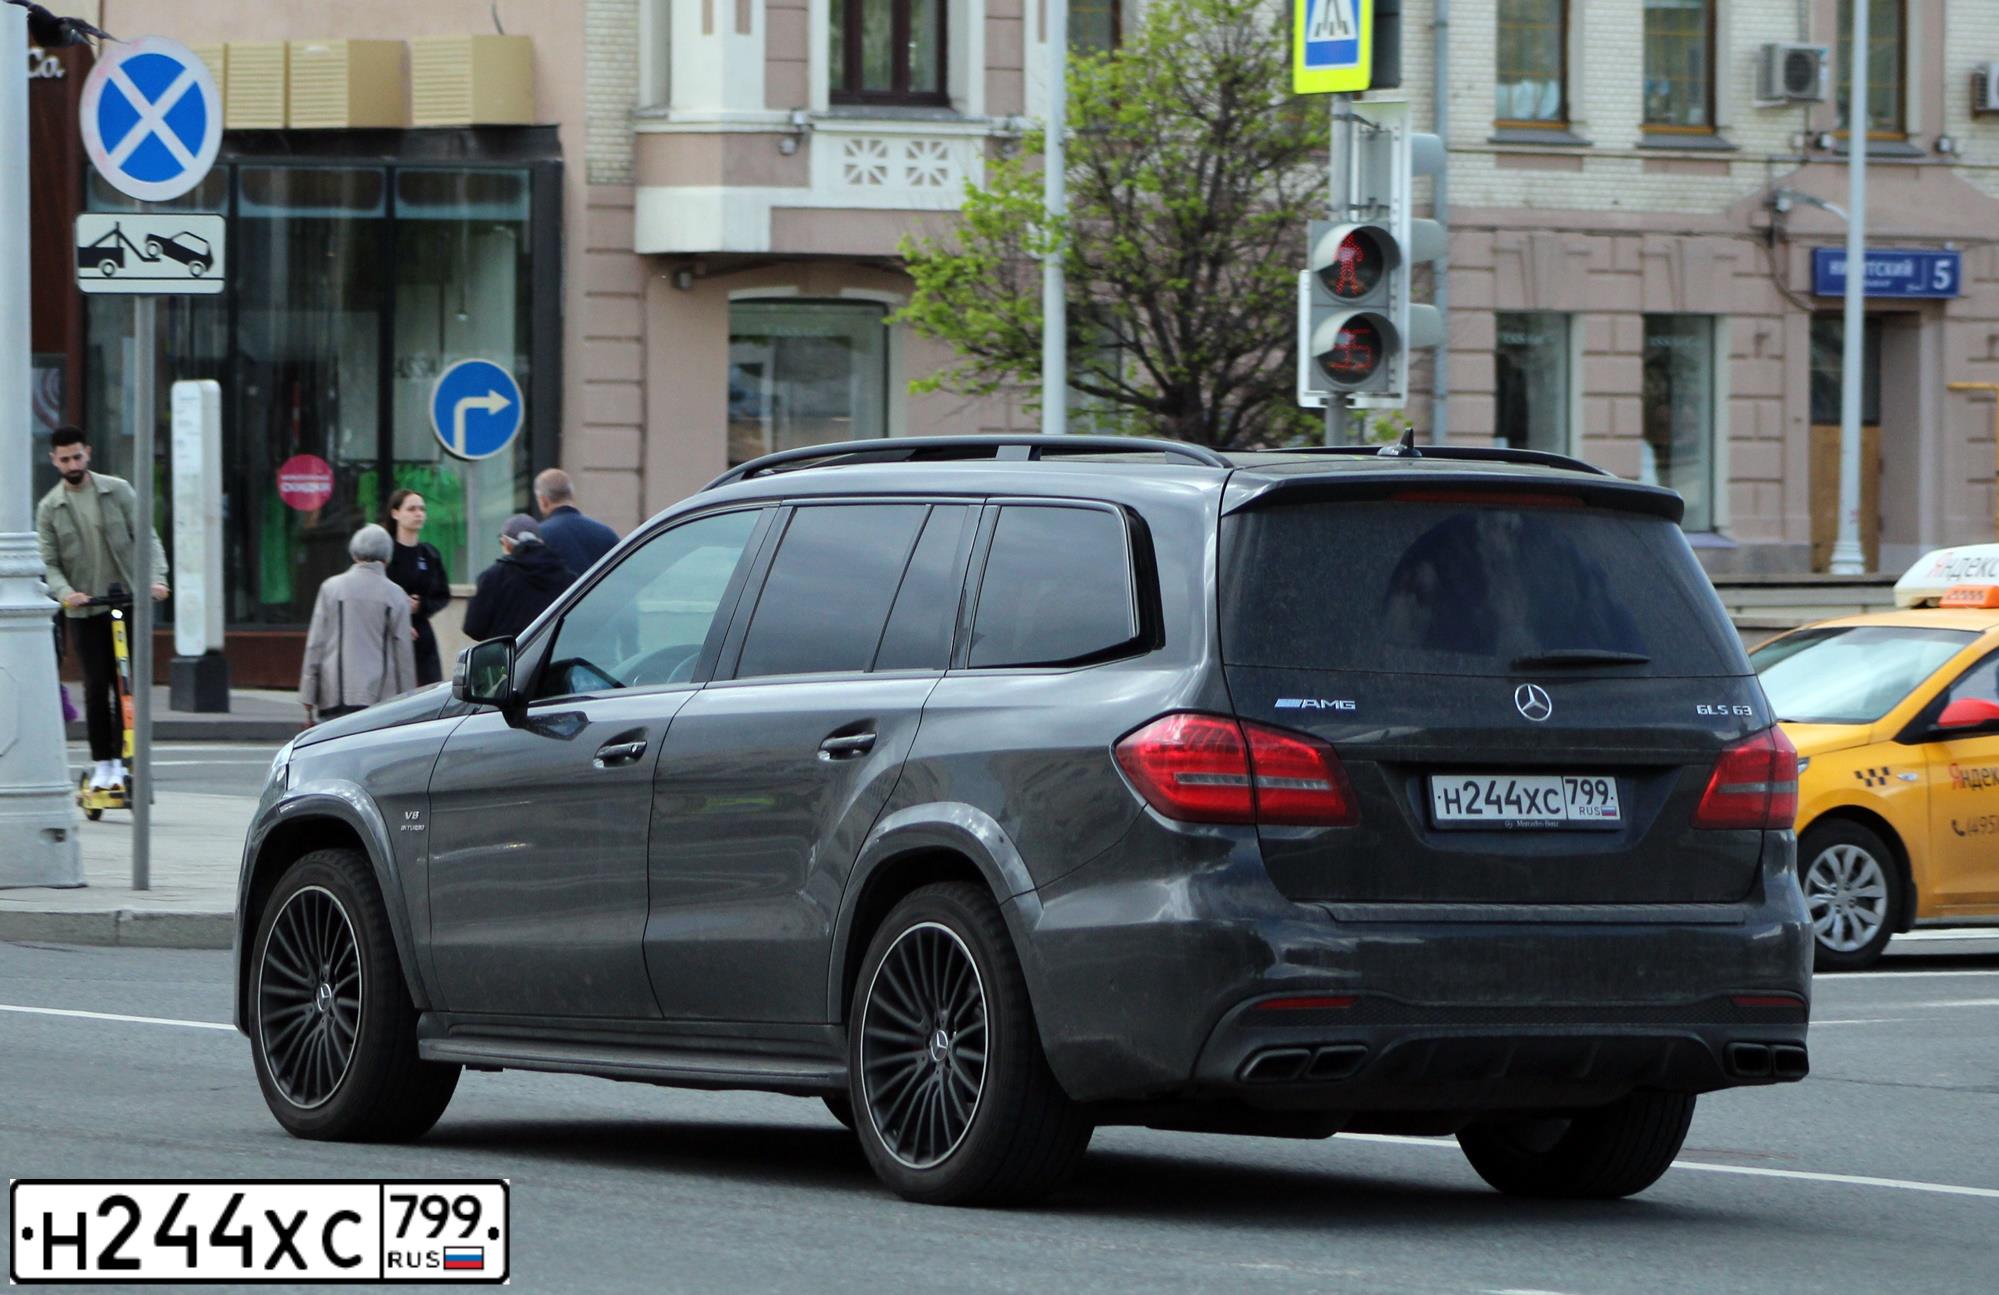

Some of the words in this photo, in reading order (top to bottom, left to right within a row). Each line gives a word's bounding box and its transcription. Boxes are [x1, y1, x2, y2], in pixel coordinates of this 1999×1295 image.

[1932, 259, 1952, 290] 5
[1301, 698, 1357, 710] AMG
[1696, 704, 1729, 716] GLS
[1732, 704, 1753, 716] 63
[1564, 778, 1609, 805] 799
[405, 811, 420, 820] V8
[1579, 806, 1601, 817] RUS
